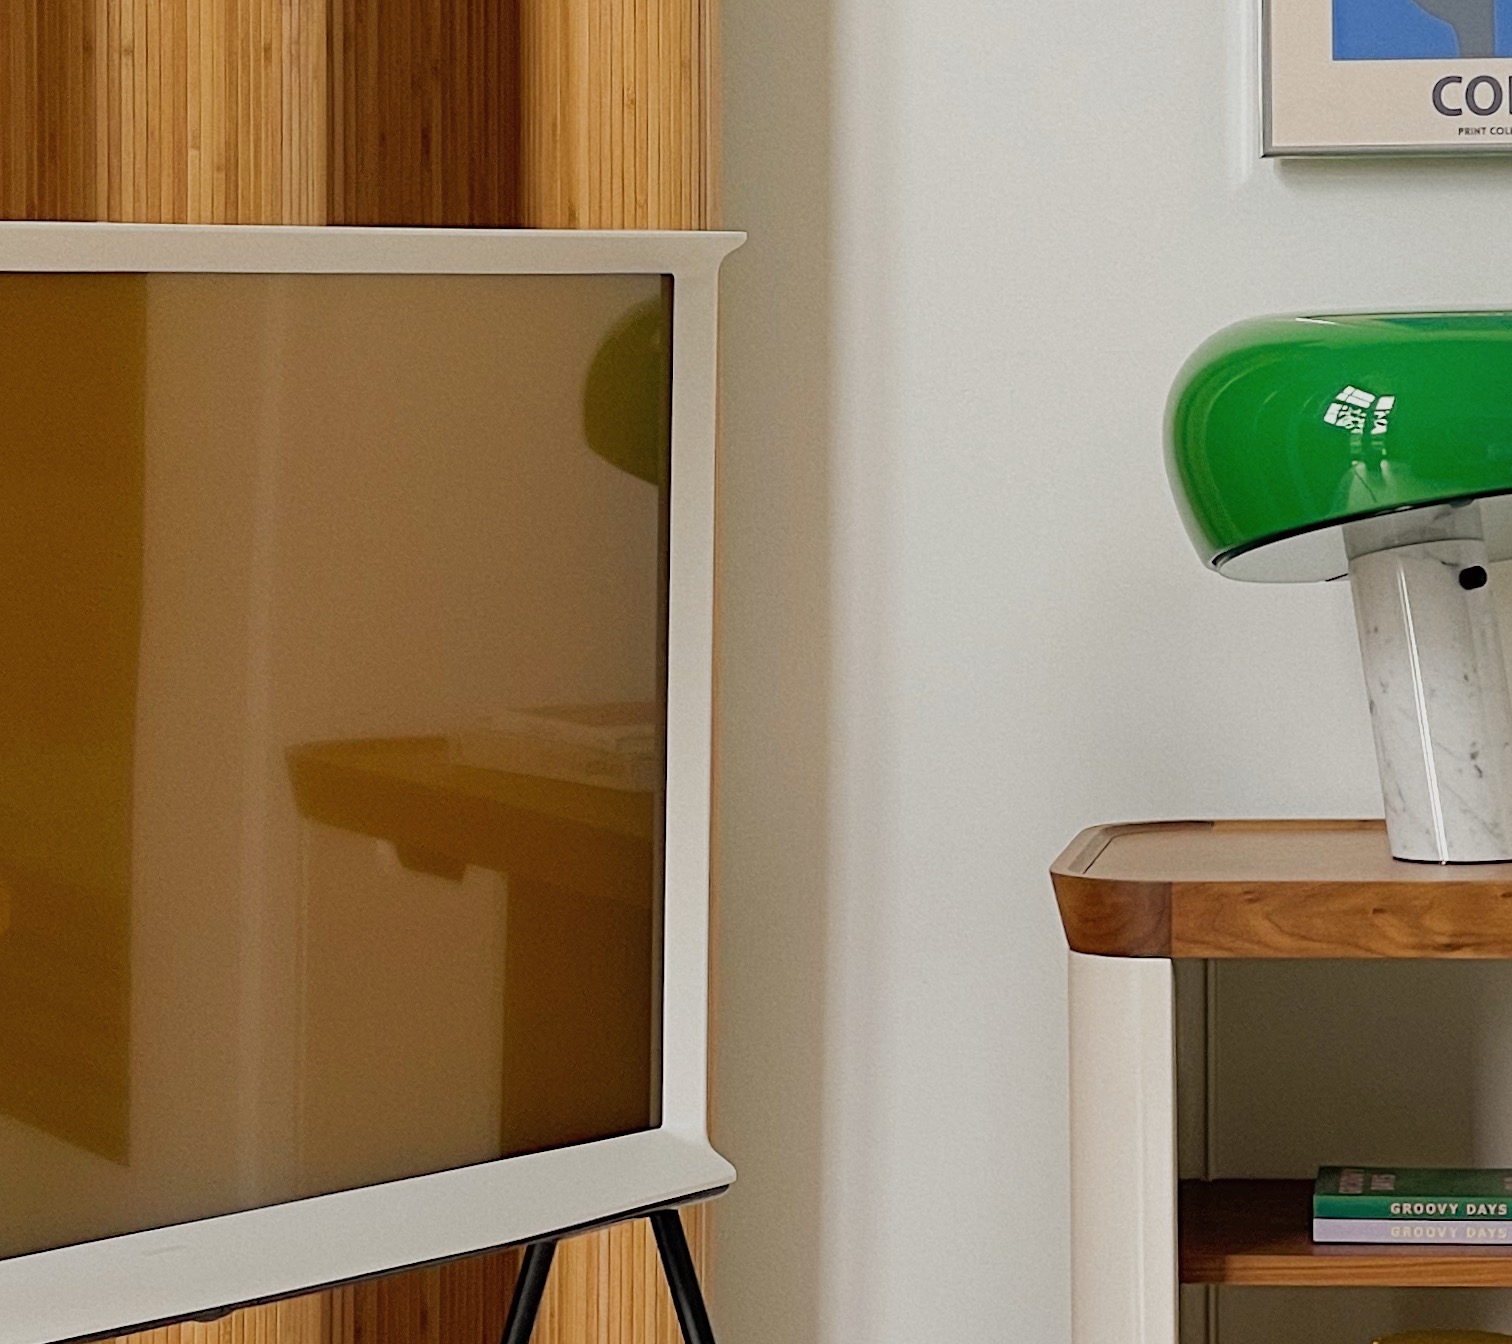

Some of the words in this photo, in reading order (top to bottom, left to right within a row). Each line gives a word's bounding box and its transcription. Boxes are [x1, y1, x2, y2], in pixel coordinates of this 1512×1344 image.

[1458, 126, 1487, 136] PRINT
[1390, 1202, 1459, 1215] GROOVY
[1466, 1203, 1508, 1216] DAYS
[1390, 1226, 1458, 1238] GROOVY
[1466, 1227, 1507, 1239] DAYS
